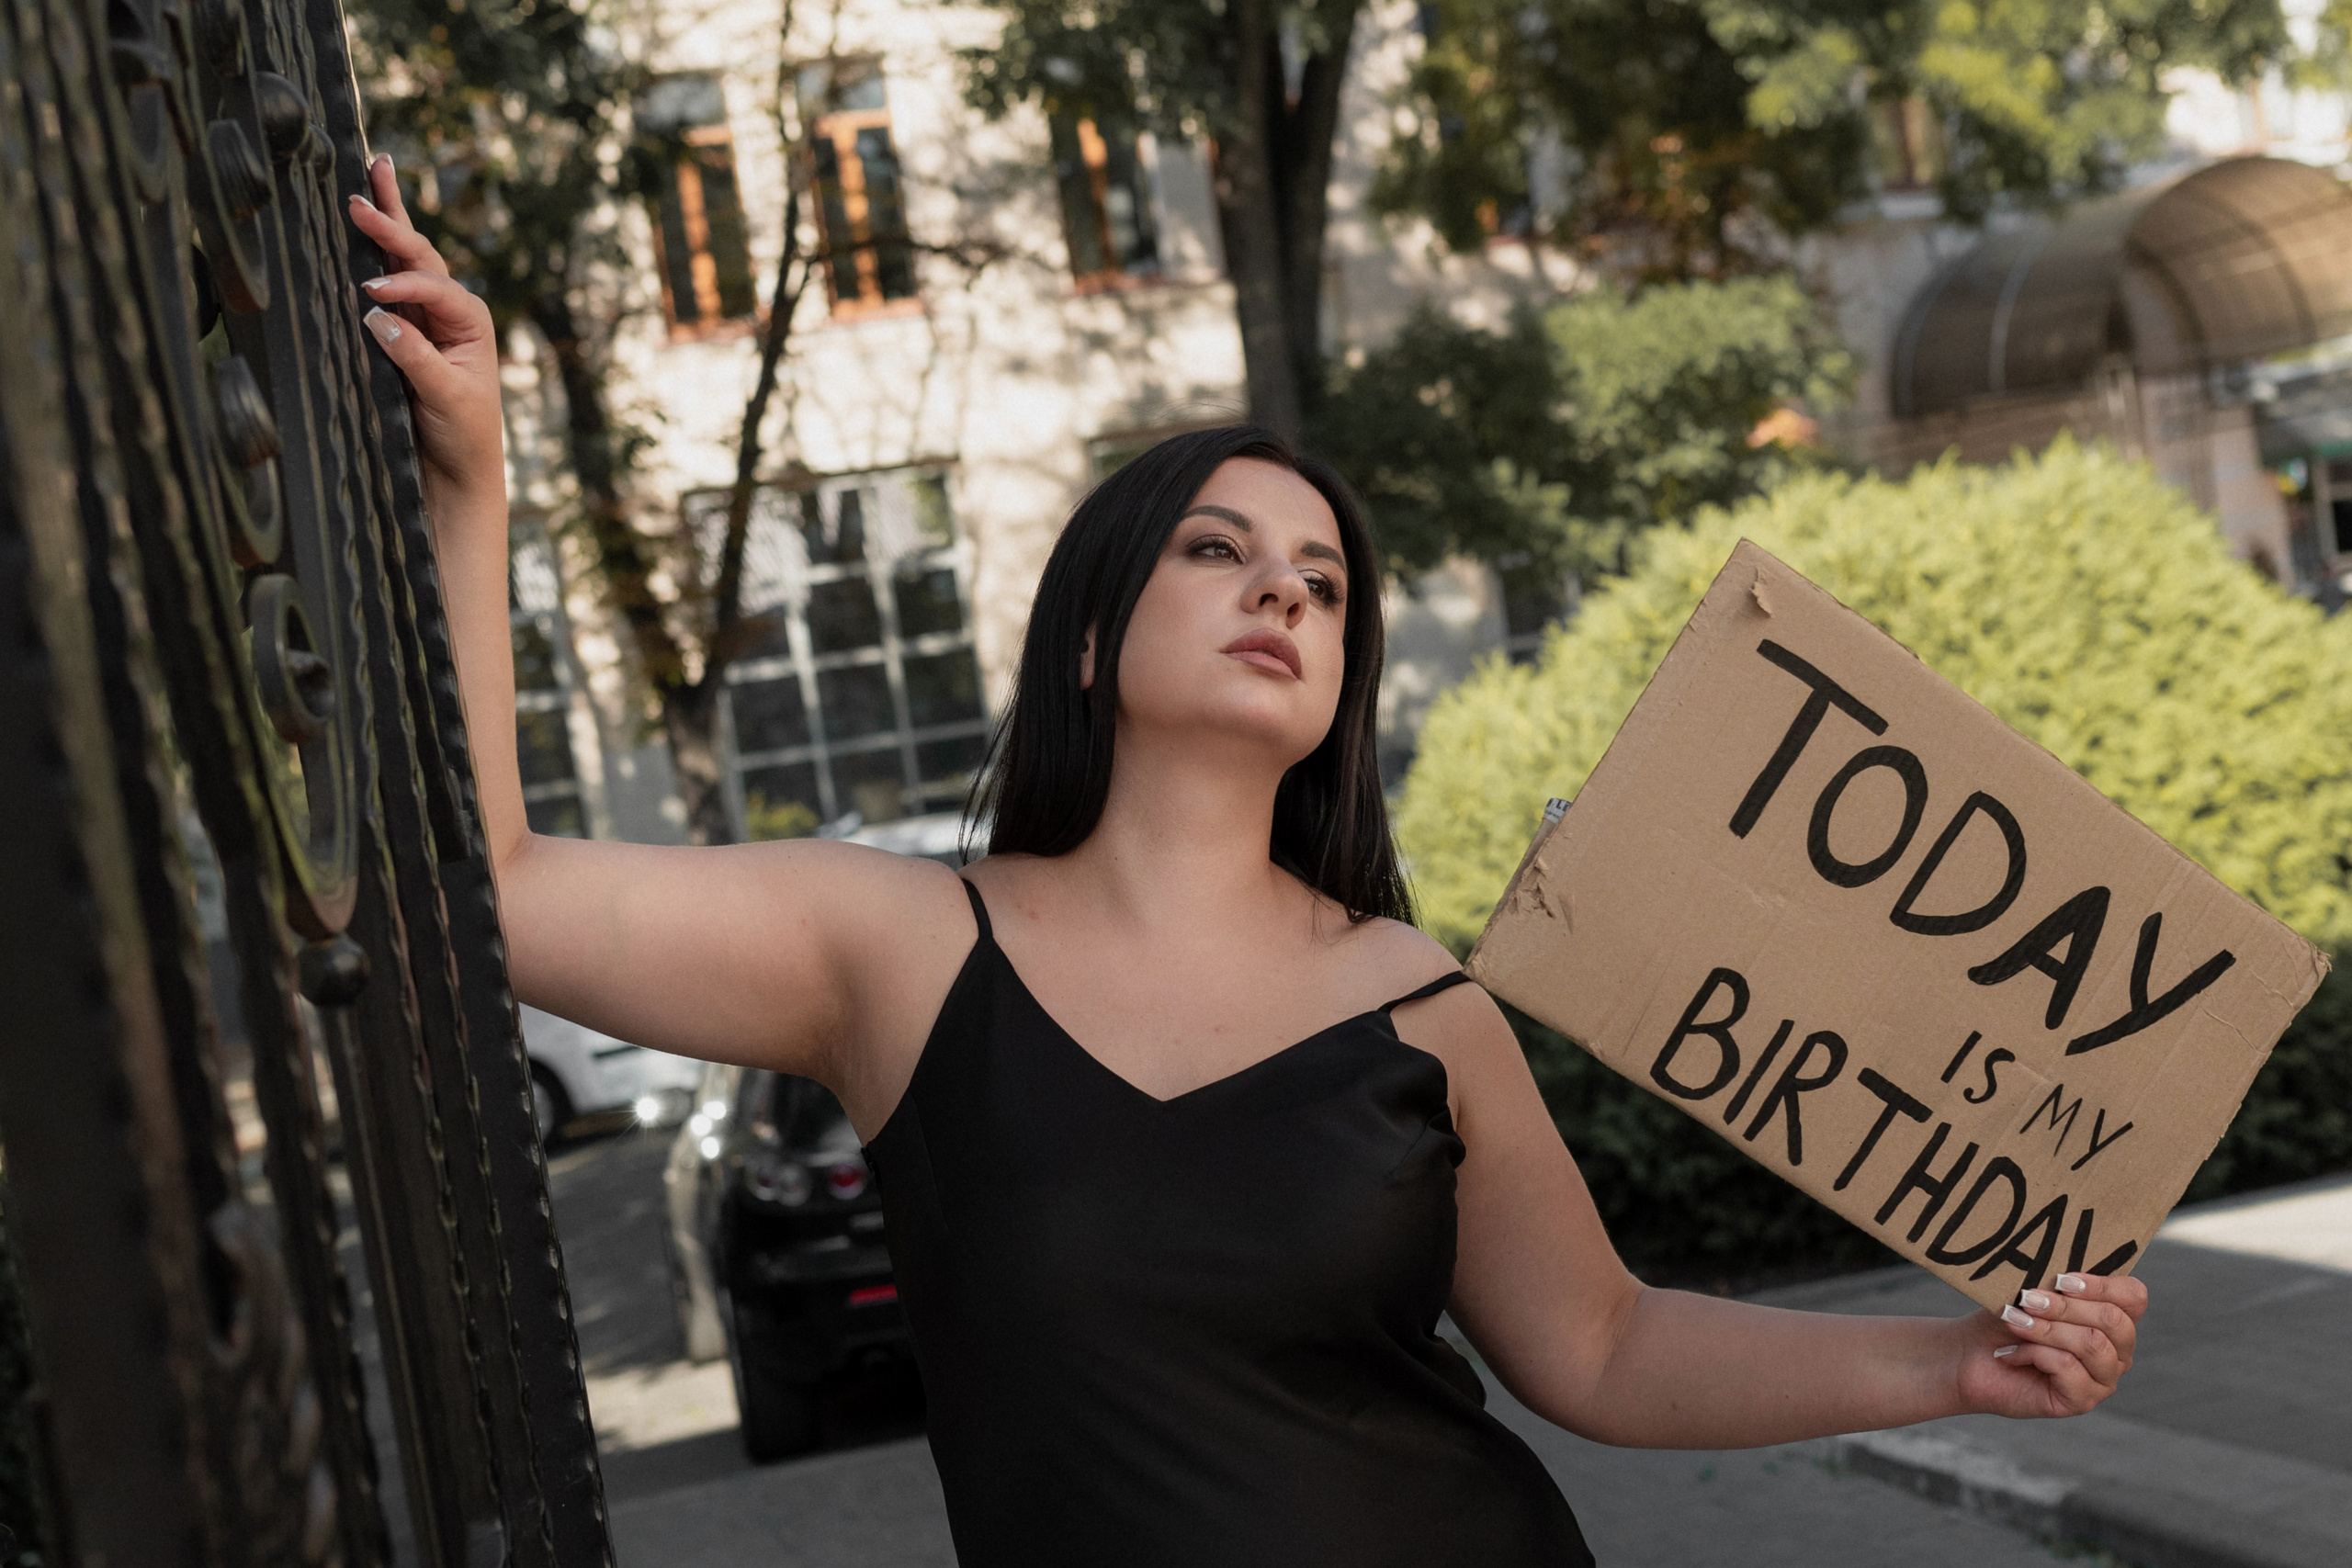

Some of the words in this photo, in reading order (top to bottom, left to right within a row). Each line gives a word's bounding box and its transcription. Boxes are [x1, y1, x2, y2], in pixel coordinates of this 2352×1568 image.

[1728, 639, 2236, 1056] TODAY
[1940, 1031, 2016, 1104] IS
[2019, 1084, 2134, 1171] MY
